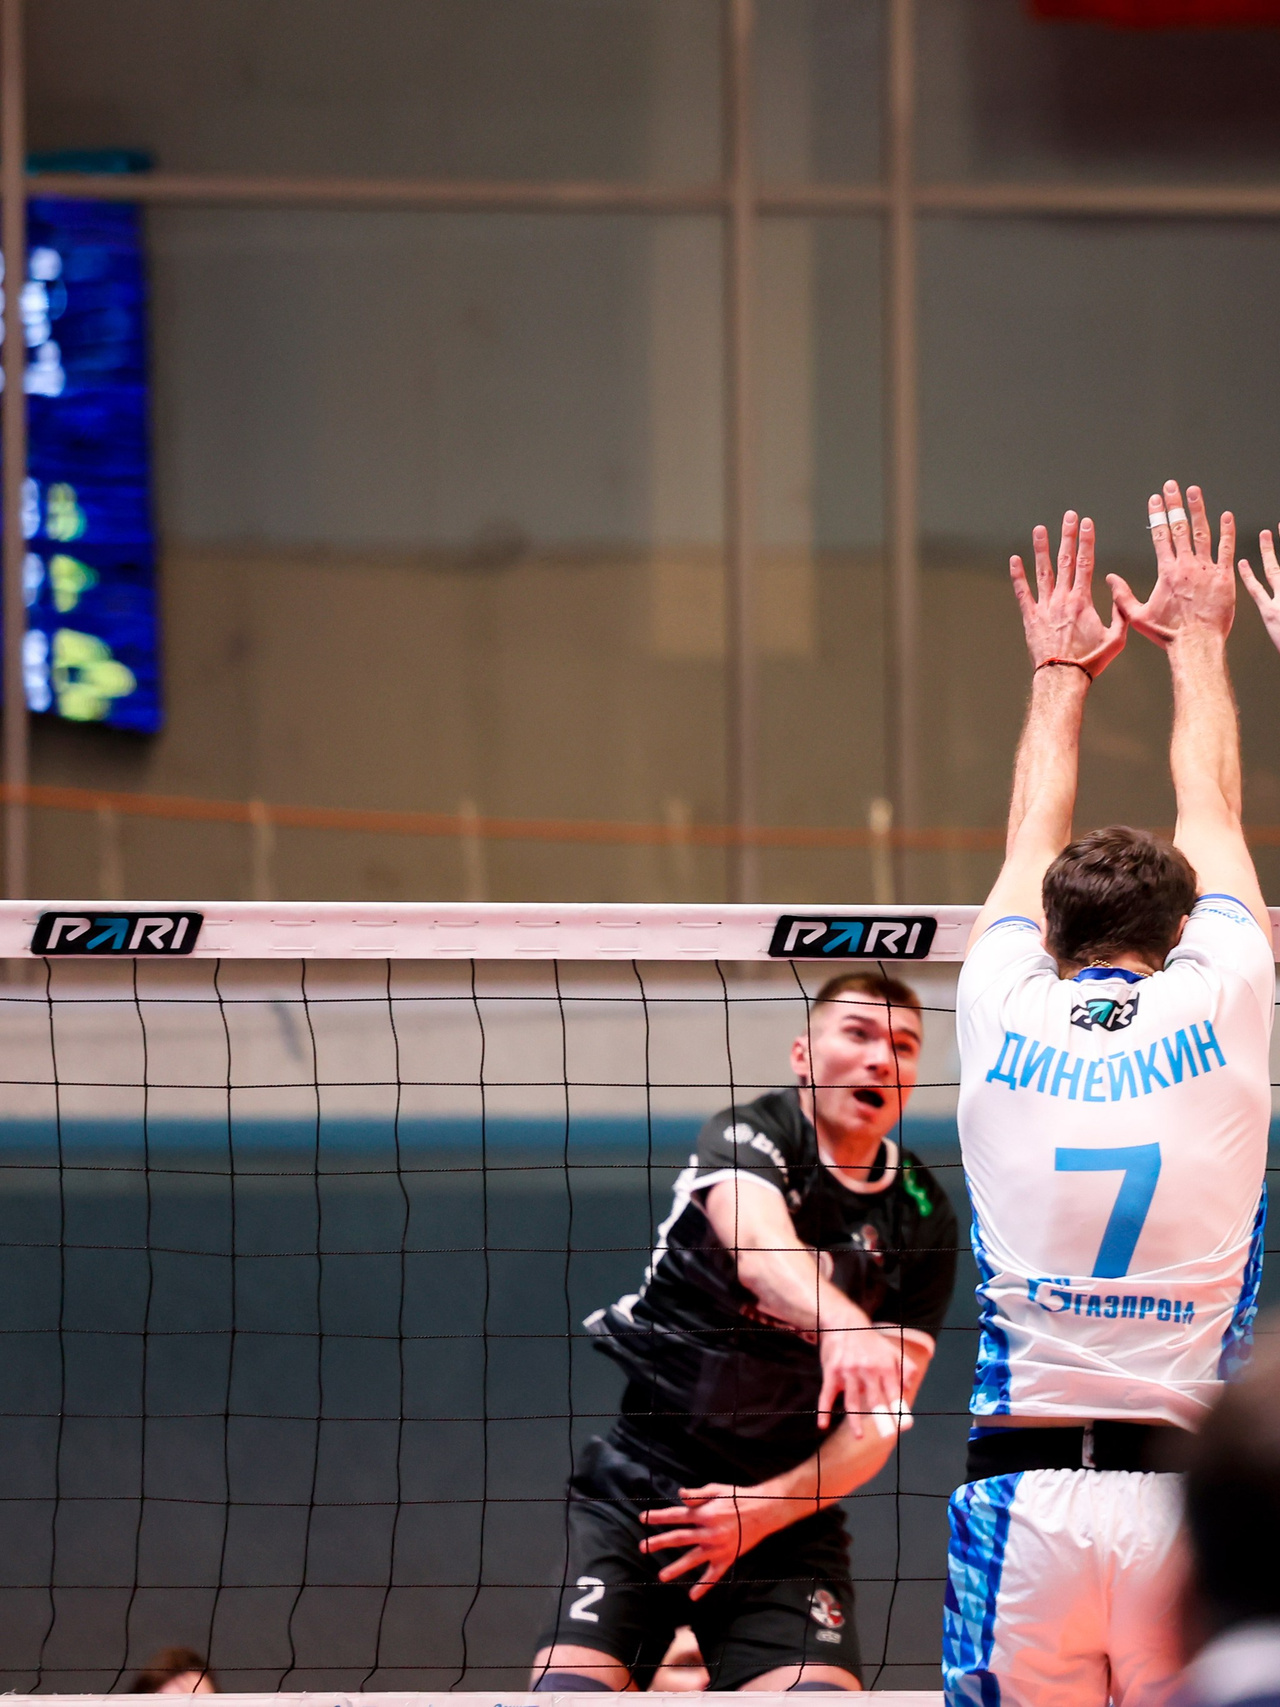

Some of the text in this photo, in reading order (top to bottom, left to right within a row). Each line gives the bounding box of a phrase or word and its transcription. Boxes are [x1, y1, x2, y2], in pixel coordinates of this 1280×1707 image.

[46, 917, 189, 949] PARI
[783, 921, 922, 954] PARI
[985, 1020, 1227, 1103] ДИНЕЙКИН
[1055, 1142, 1162, 1279] 7
[1074, 1293, 1195, 1324] ГАЗПРОМ
[569, 1576, 605, 1623] 2
